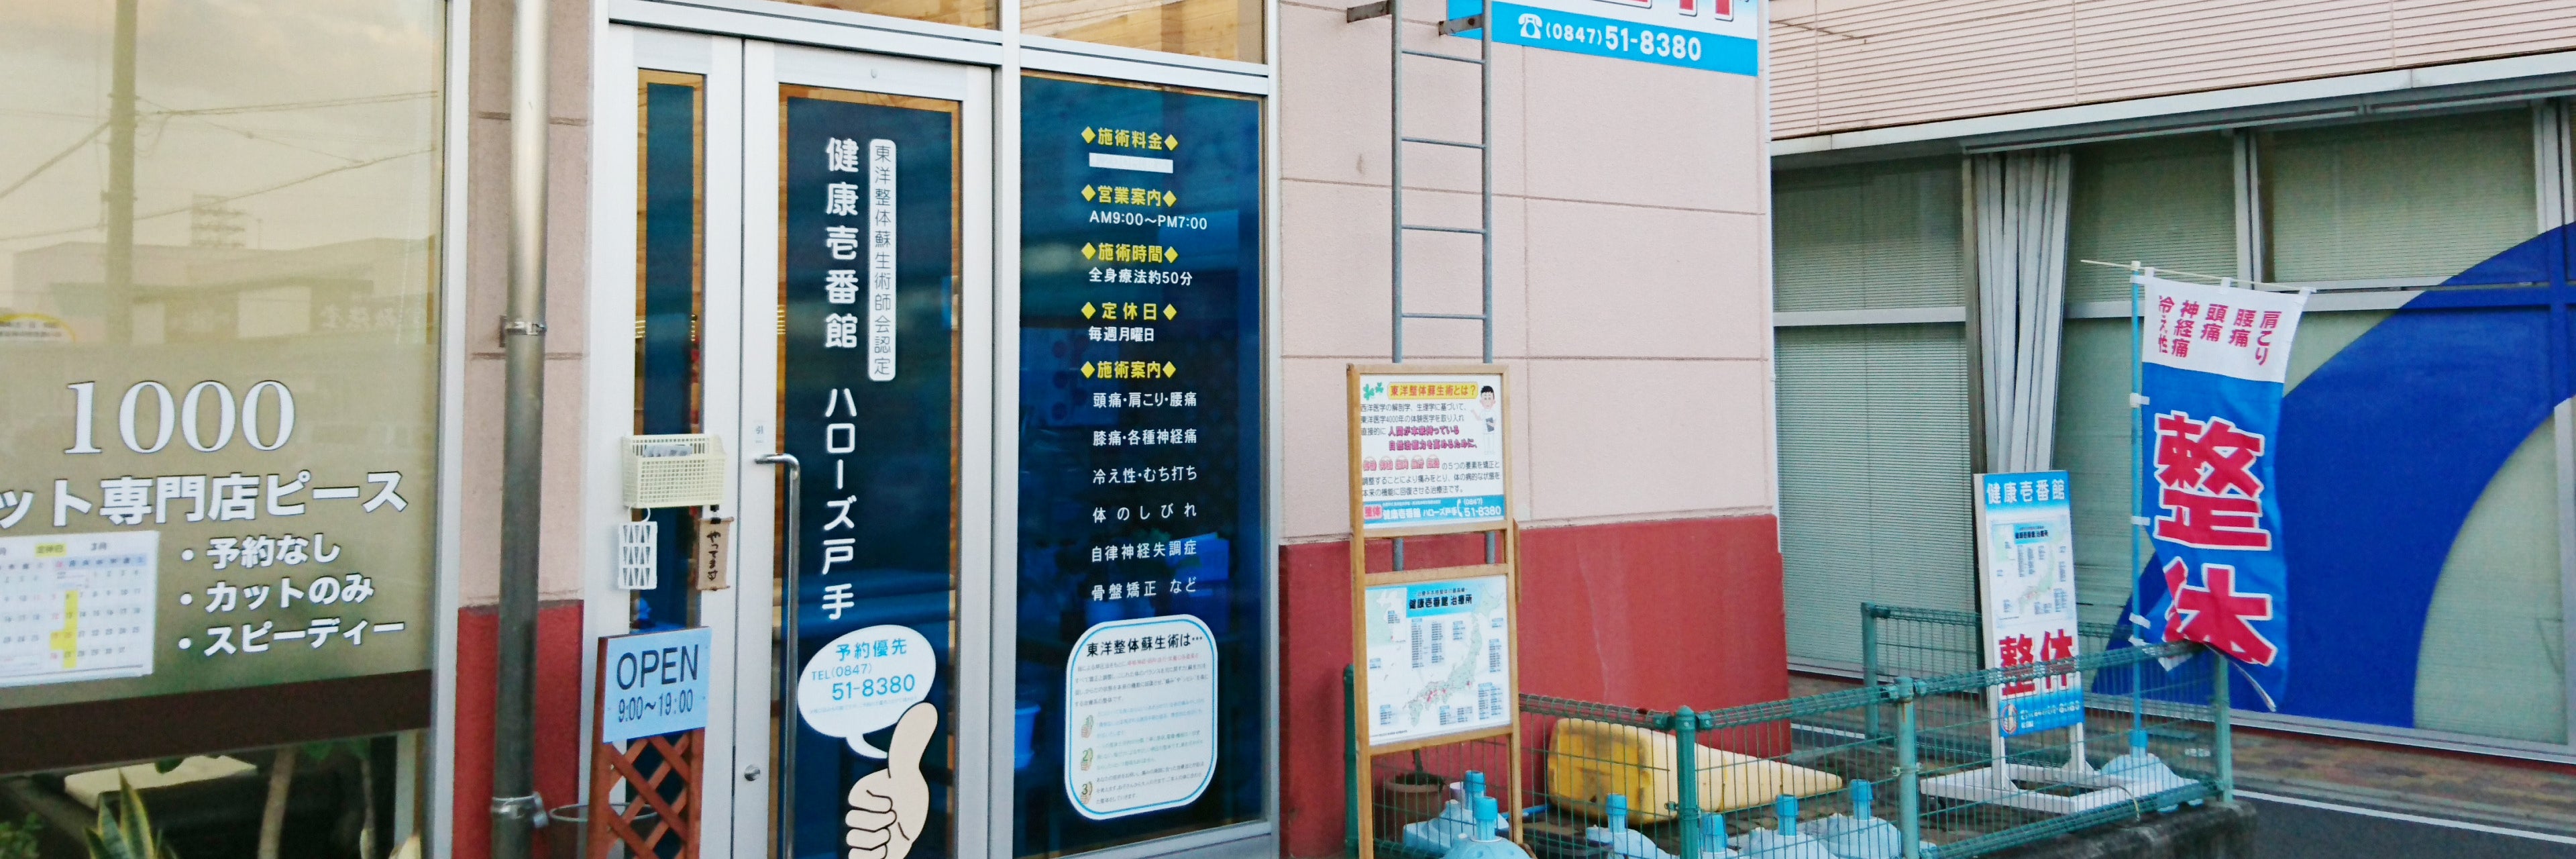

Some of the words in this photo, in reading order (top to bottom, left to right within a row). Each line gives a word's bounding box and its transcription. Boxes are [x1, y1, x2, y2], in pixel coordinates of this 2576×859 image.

[1546, 22, 1702, 61] (0847)51-8380
[1097, 128, 1163, 150] 施術料金
[1097, 185, 1161, 207] 営業案内
[825, 137, 859, 348] 健康壱番館
[1097, 242, 1163, 263] 施術時間
[874, 145, 892, 376] 東洋整体蘇生術師会認定
[1089, 267, 1193, 286] 全身療法約50分
[1102, 302, 1157, 321] 定休日
[2158, 295, 2176, 354] 冷え性
[2200, 303, 2229, 342] 頭痛
[1088, 326, 1155, 342] 毎週月曜日
[2171, 300, 2200, 358] 神経痛
[2228, 308, 2257, 348] 腰痛
[2255, 310, 2283, 366] 肩こり
[1097, 360, 1161, 378] 施術案内
[1093, 391, 1197, 409] 頭痛・肩こり・腰痛
[63, 380, 295, 456] 1000
[1093, 428, 1197, 447] 膝痛・各種神経痛
[1093, 465, 1197, 485] 冷え性・むち打ち
[0, 470, 408, 529] ット専門店ピース
[821, 387, 857, 621] ハローズ戸手
[1986, 478, 2065, 505] 健康壱番館
[1093, 503, 1197, 523] 体のしびれ
[1464, 505, 1501, 517] 51-8380
[2155, 410, 2277, 666] 整体
[1091, 540, 1197, 563] 自律神経失調症
[1091, 580, 1157, 602] 骨盤矯正
[1169, 576, 1196, 595] など
[836, 638, 908, 662] 予約優先
[1998, 628, 2073, 696] 整体
[616, 644, 699, 691] OPEN
[812, 663, 872, 681] TEL(0847)
[832, 674, 916, 701] 51-8380
